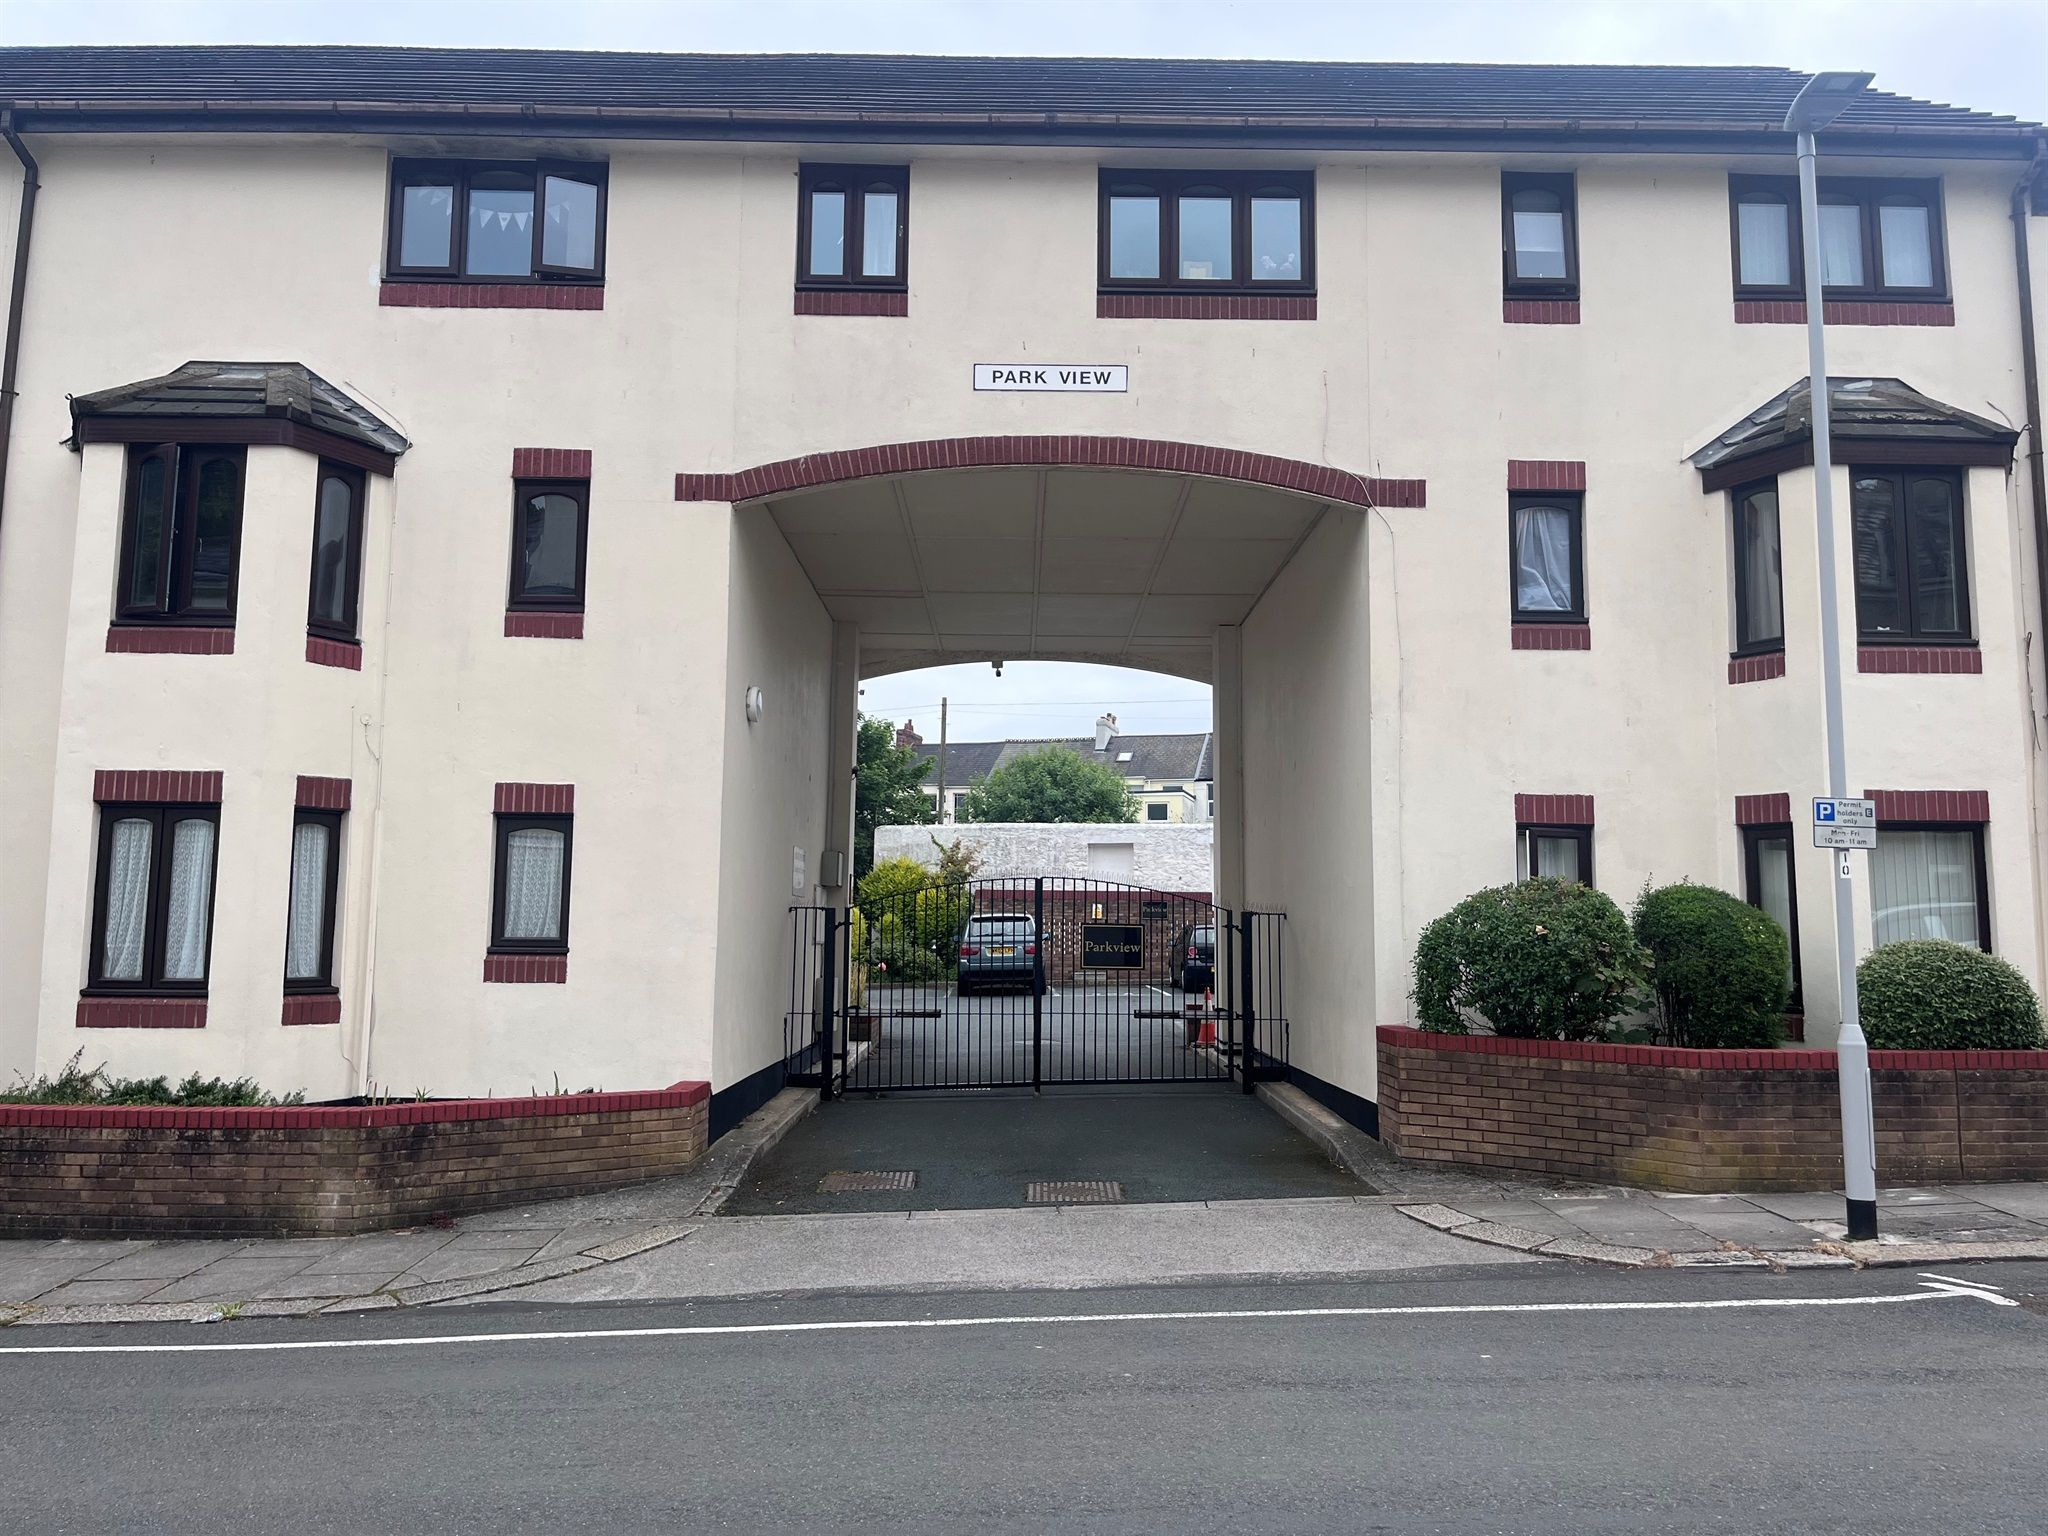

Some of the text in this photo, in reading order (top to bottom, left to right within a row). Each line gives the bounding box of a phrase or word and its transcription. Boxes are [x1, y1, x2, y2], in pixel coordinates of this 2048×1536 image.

[992, 370, 1112, 385] PARK VIEW
[1819, 803, 1832, 820] P
[1837, 809, 1863, 817] holders
[1084, 940, 1141, 953] Parkview
